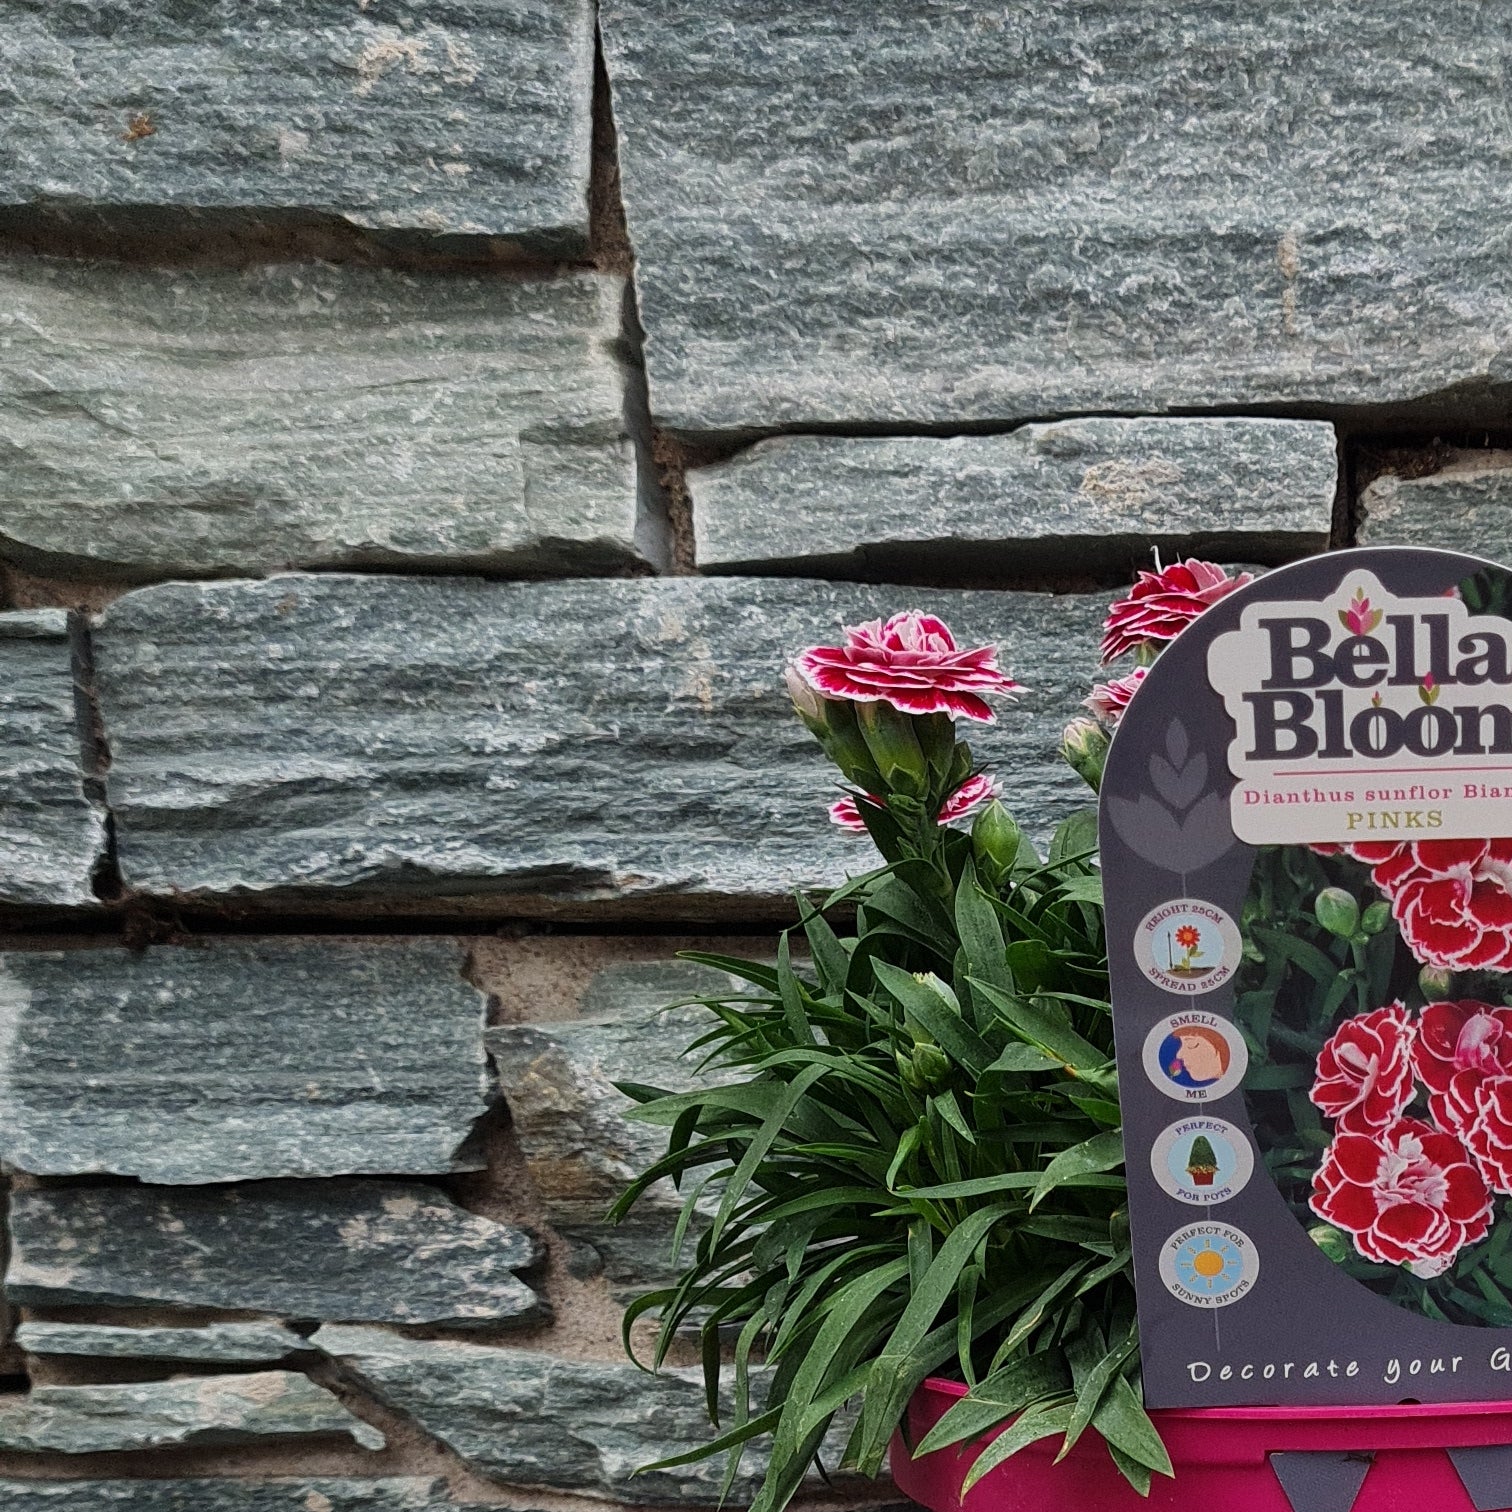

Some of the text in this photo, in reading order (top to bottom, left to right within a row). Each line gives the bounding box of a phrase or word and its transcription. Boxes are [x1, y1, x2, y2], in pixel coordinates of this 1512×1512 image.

[1244, 788, 1356, 806] Dianthus
[1364, 785, 1453, 803] sunflor
[1346, 810, 1444, 830] PINKS
[1145, 904, 1188, 932] HEIGHT
[1149, 965, 1230, 992] SPREAD 25CM
[1170, 1014, 1218, 1028] SMELL
[1185, 1090, 1207, 1098] ME
[1175, 1121, 1228, 1135] PERFECT
[1176, 1187, 1232, 1201] FOR POTS
[1170, 1226, 1244, 1250] PERFECT FOR
[1172, 1280, 1250, 1305] SUNNY SPOTS
[1187, 1360, 1360, 1383] Decorate
[1384, 1354, 1463, 1384] your
